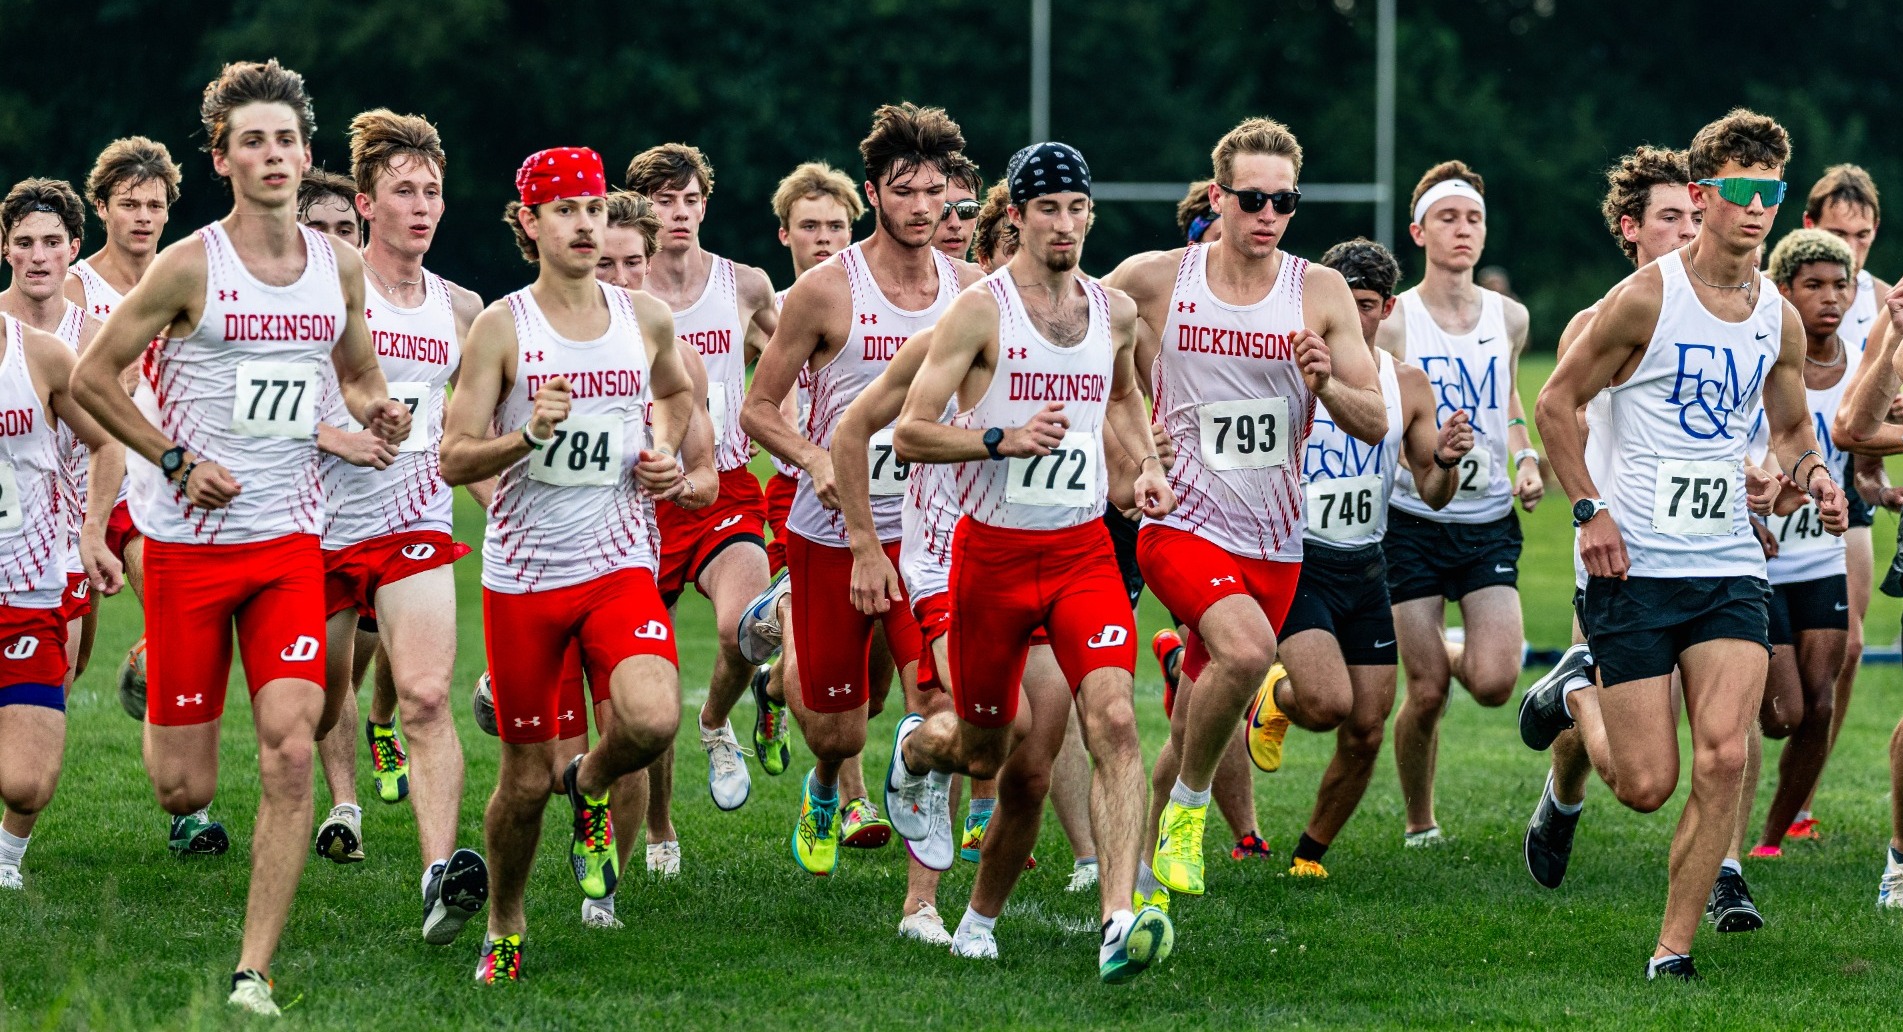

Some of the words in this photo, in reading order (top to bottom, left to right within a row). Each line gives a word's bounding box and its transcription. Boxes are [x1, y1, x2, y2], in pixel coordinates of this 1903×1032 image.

[224, 314, 335, 341] DICKINSON
[1178, 325, 1292, 361] DICKINSON
[247, 379, 306, 421] 777
[544, 430, 610, 471] 784
[1213, 414, 1276, 454] 793
[1022, 449, 1086, 490] 772
[1320, 489, 1372, 529] 746
[1668, 477, 1728, 519] 752
